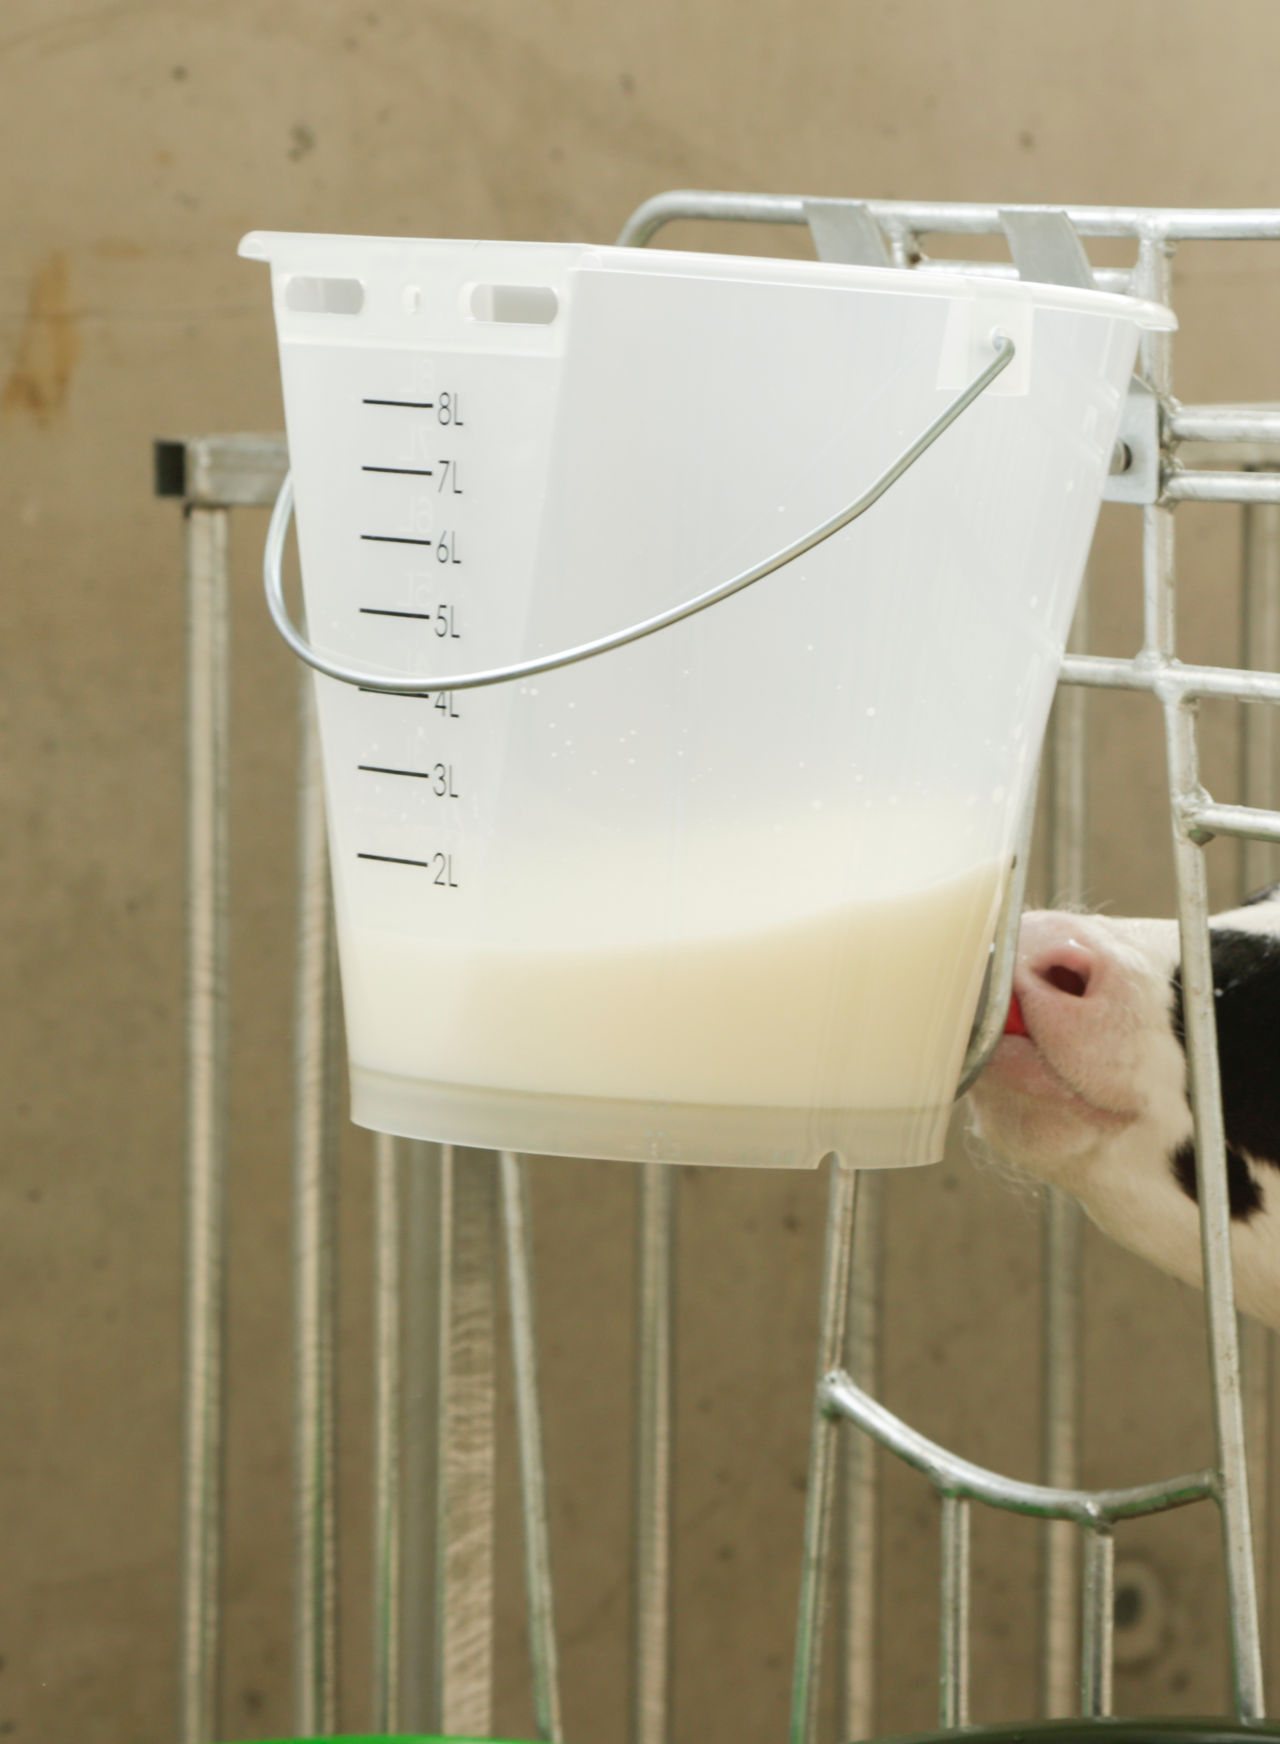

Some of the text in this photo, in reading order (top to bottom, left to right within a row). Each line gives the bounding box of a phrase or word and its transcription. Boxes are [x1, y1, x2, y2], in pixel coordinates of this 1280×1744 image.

[437, 392, 464, 426] 8L
[438, 460, 463, 494] 7L
[436, 530, 462, 564] 6L
[434, 605, 460, 638] 5L
[434, 690, 460, 718] 4L
[433, 763, 459, 798] 3L
[433, 852, 458, 888] 2L
